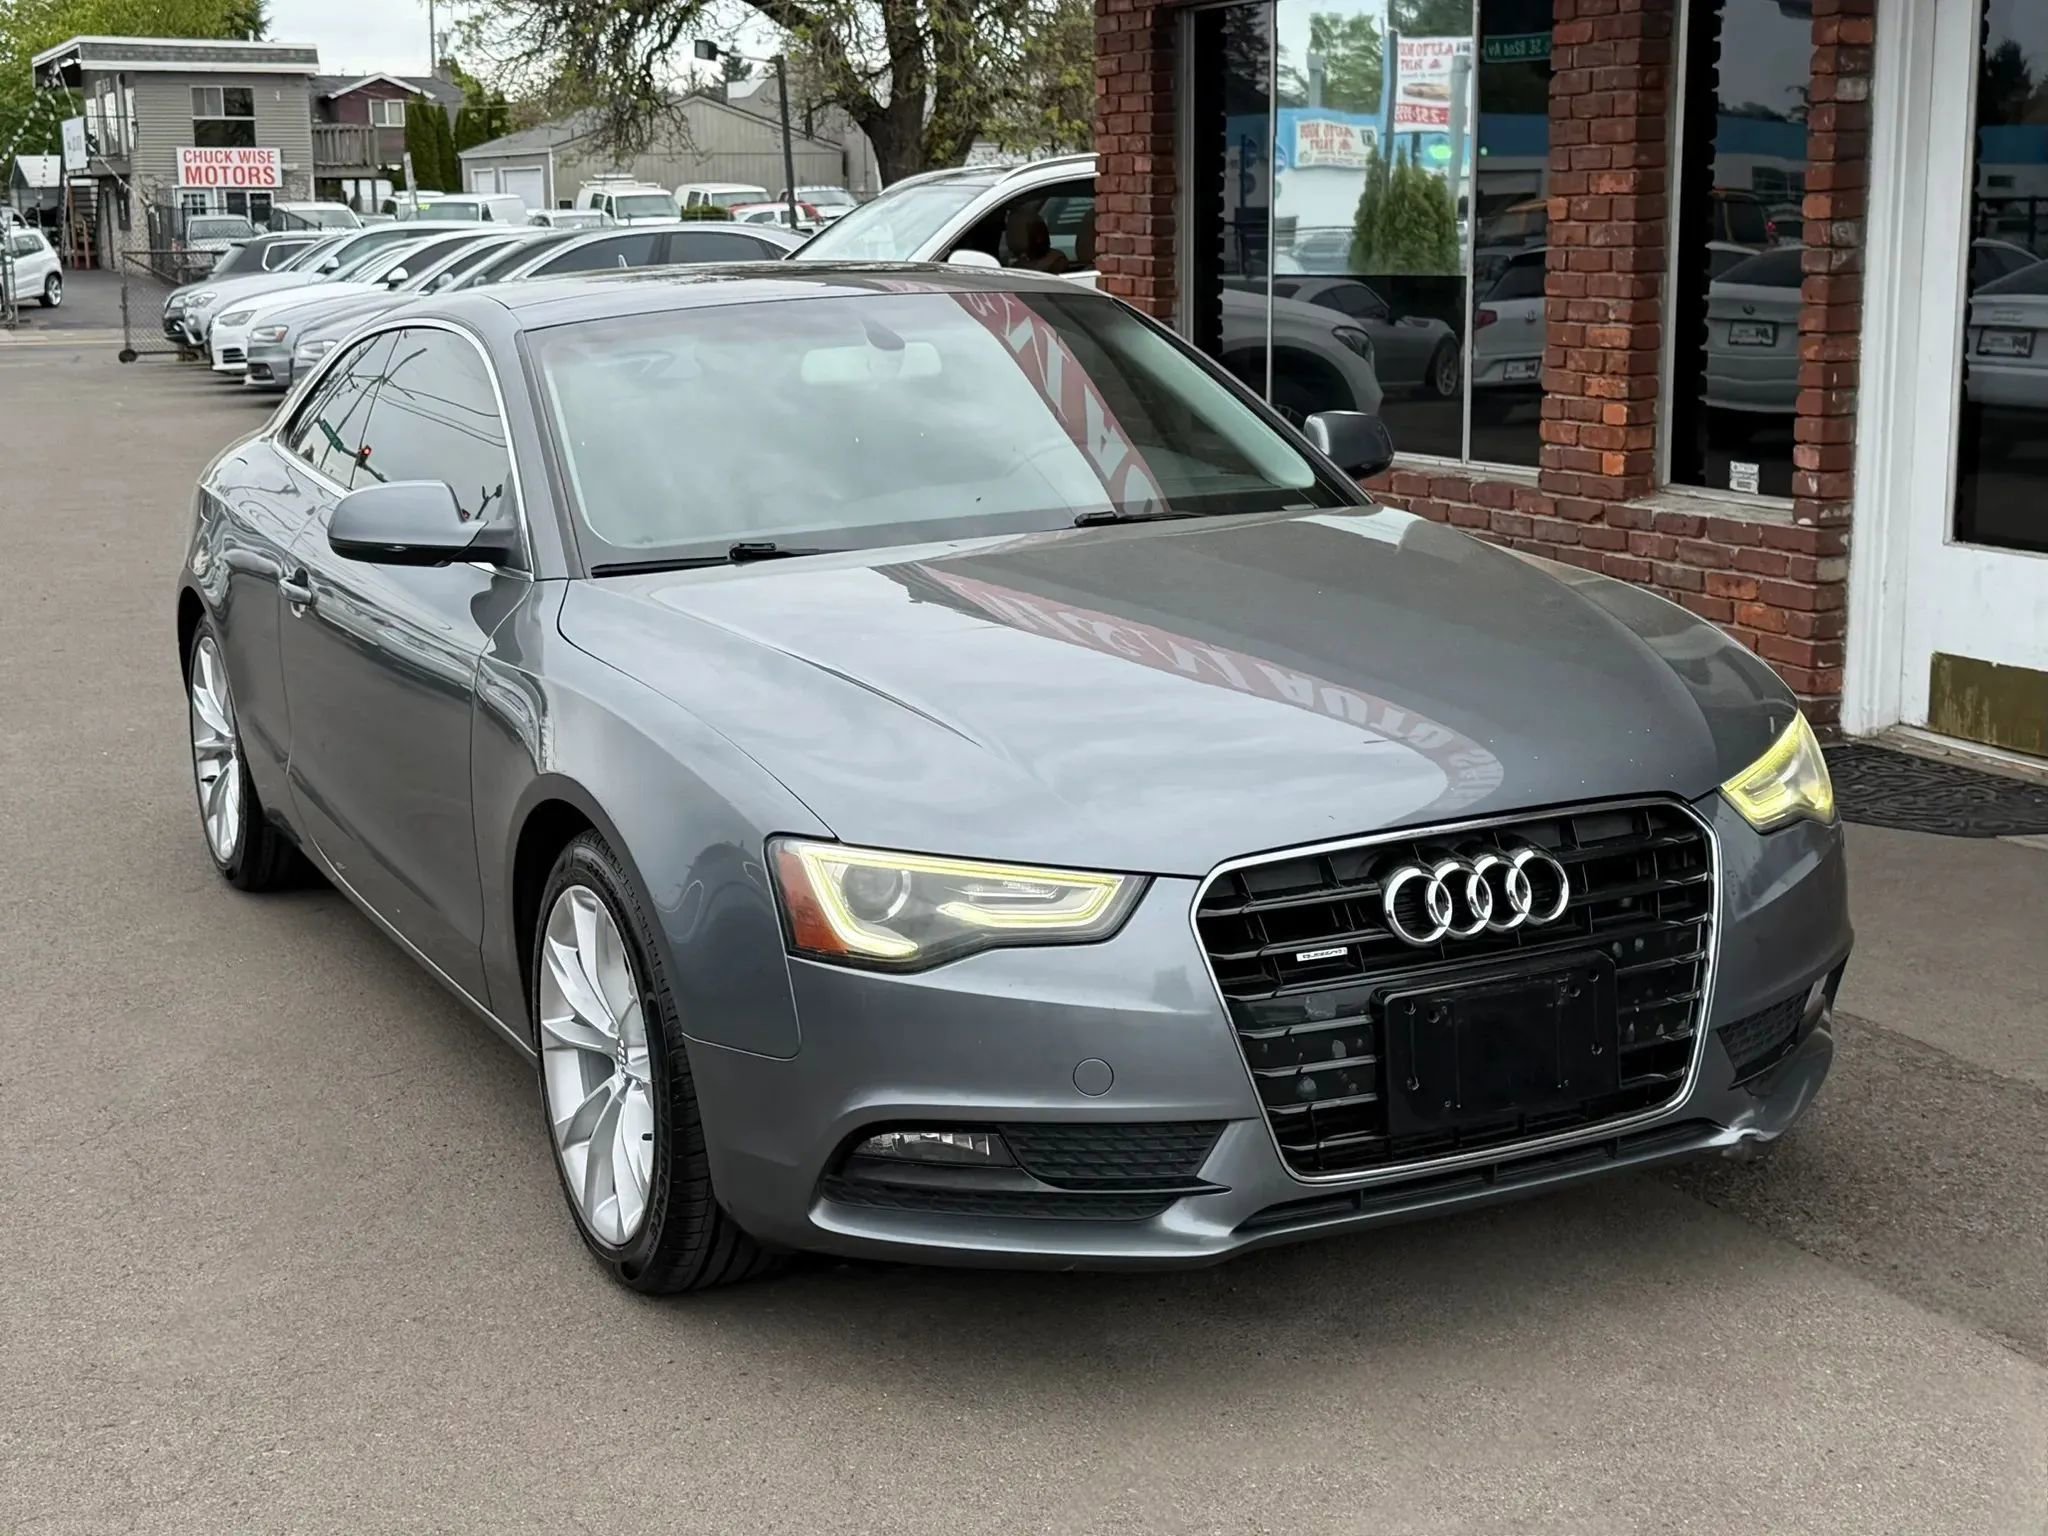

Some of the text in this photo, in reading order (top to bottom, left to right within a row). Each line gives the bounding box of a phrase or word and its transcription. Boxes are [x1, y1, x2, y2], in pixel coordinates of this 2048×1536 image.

[183, 150, 275, 164] CHUCK WISE
[185, 166, 276, 185] MOTORS
